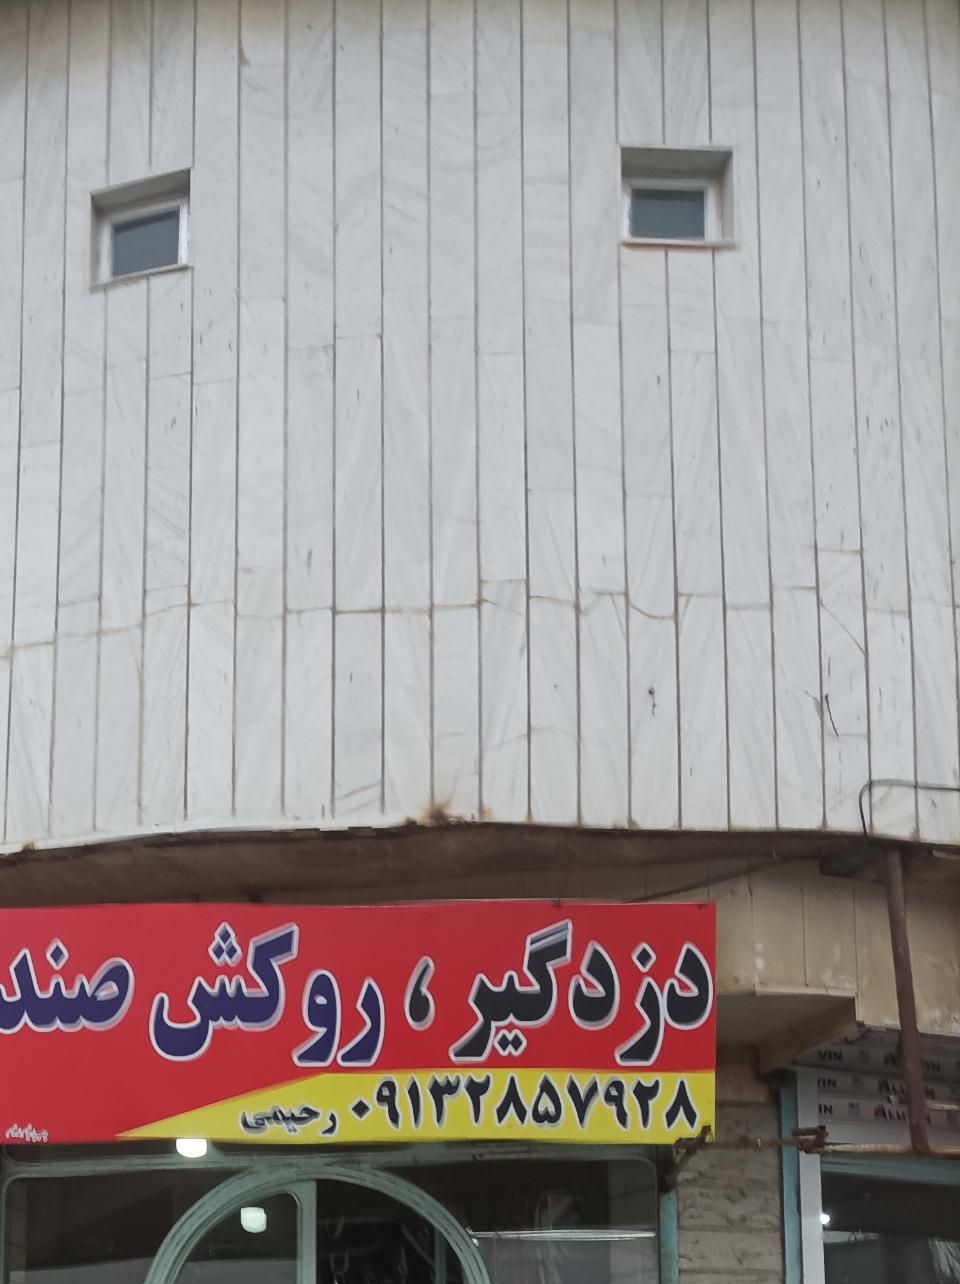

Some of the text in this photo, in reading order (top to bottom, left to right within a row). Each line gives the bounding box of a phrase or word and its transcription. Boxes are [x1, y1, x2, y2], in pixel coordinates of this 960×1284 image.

[149, 922, 386, 1066] روکش
[450, 919, 714, 1065] دزدگیر
[240, 1073, 699, 1136] ۰۹۱۳۲۸۵۷۹۲۸ رحیمی
